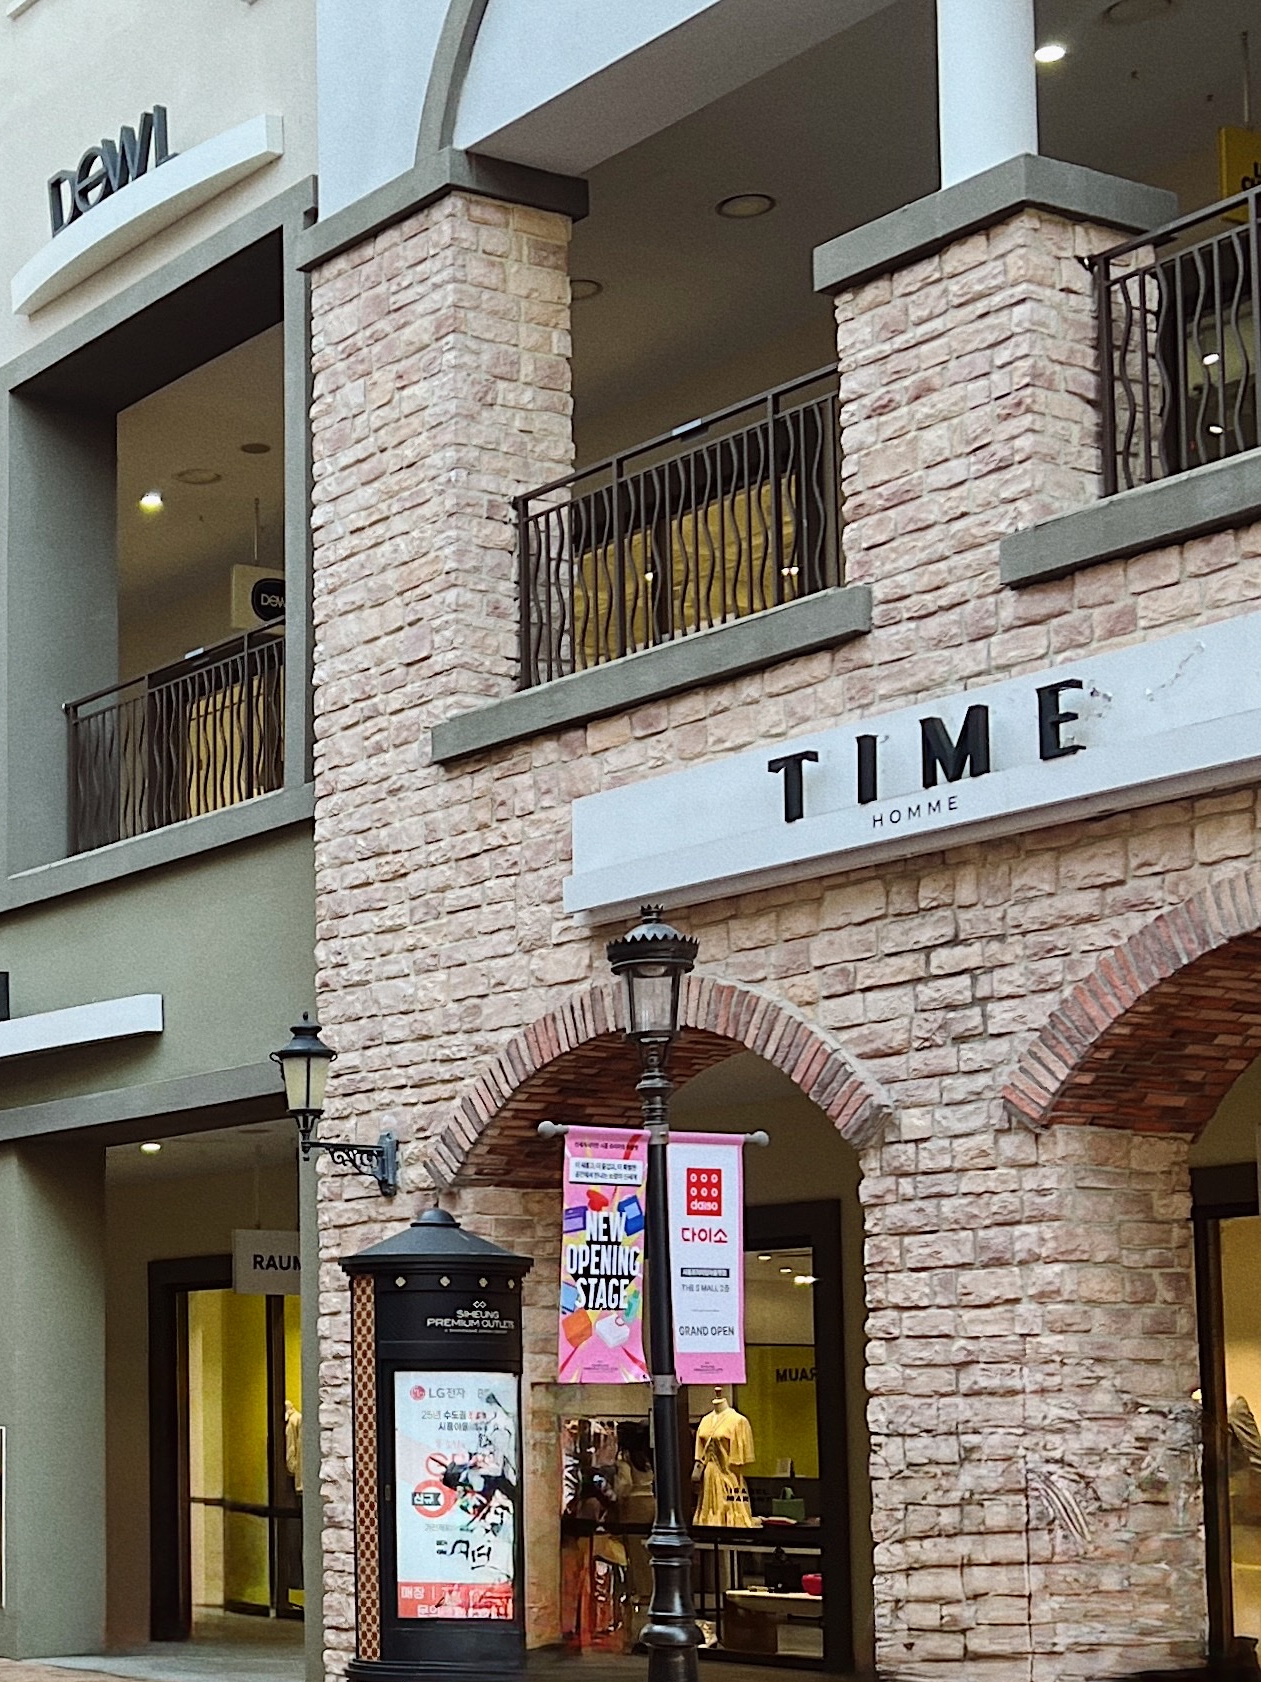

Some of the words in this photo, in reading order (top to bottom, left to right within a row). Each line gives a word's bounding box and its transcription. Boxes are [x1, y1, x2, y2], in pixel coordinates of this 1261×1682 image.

[767, 678, 1087, 823] TIME
[872, 795, 960, 828] HOMME
[690, 1199, 719, 1211] daiso
[586, 1211, 627, 1242] NEW
[681, 1227, 728, 1243] 다이소
[566, 1244, 641, 1277] OPENING
[574, 1277, 630, 1310] STAGE
[701, 1284, 719, 1293] MALL
[456, 1309, 500, 1320] SIHEUNG
[426, 1318, 480, 1328] PREMIUM
[481, 1319, 515, 1329] OUTLETS
[679, 1325, 709, 1337] GRAND
[710, 1325, 735, 1337] OPEN
